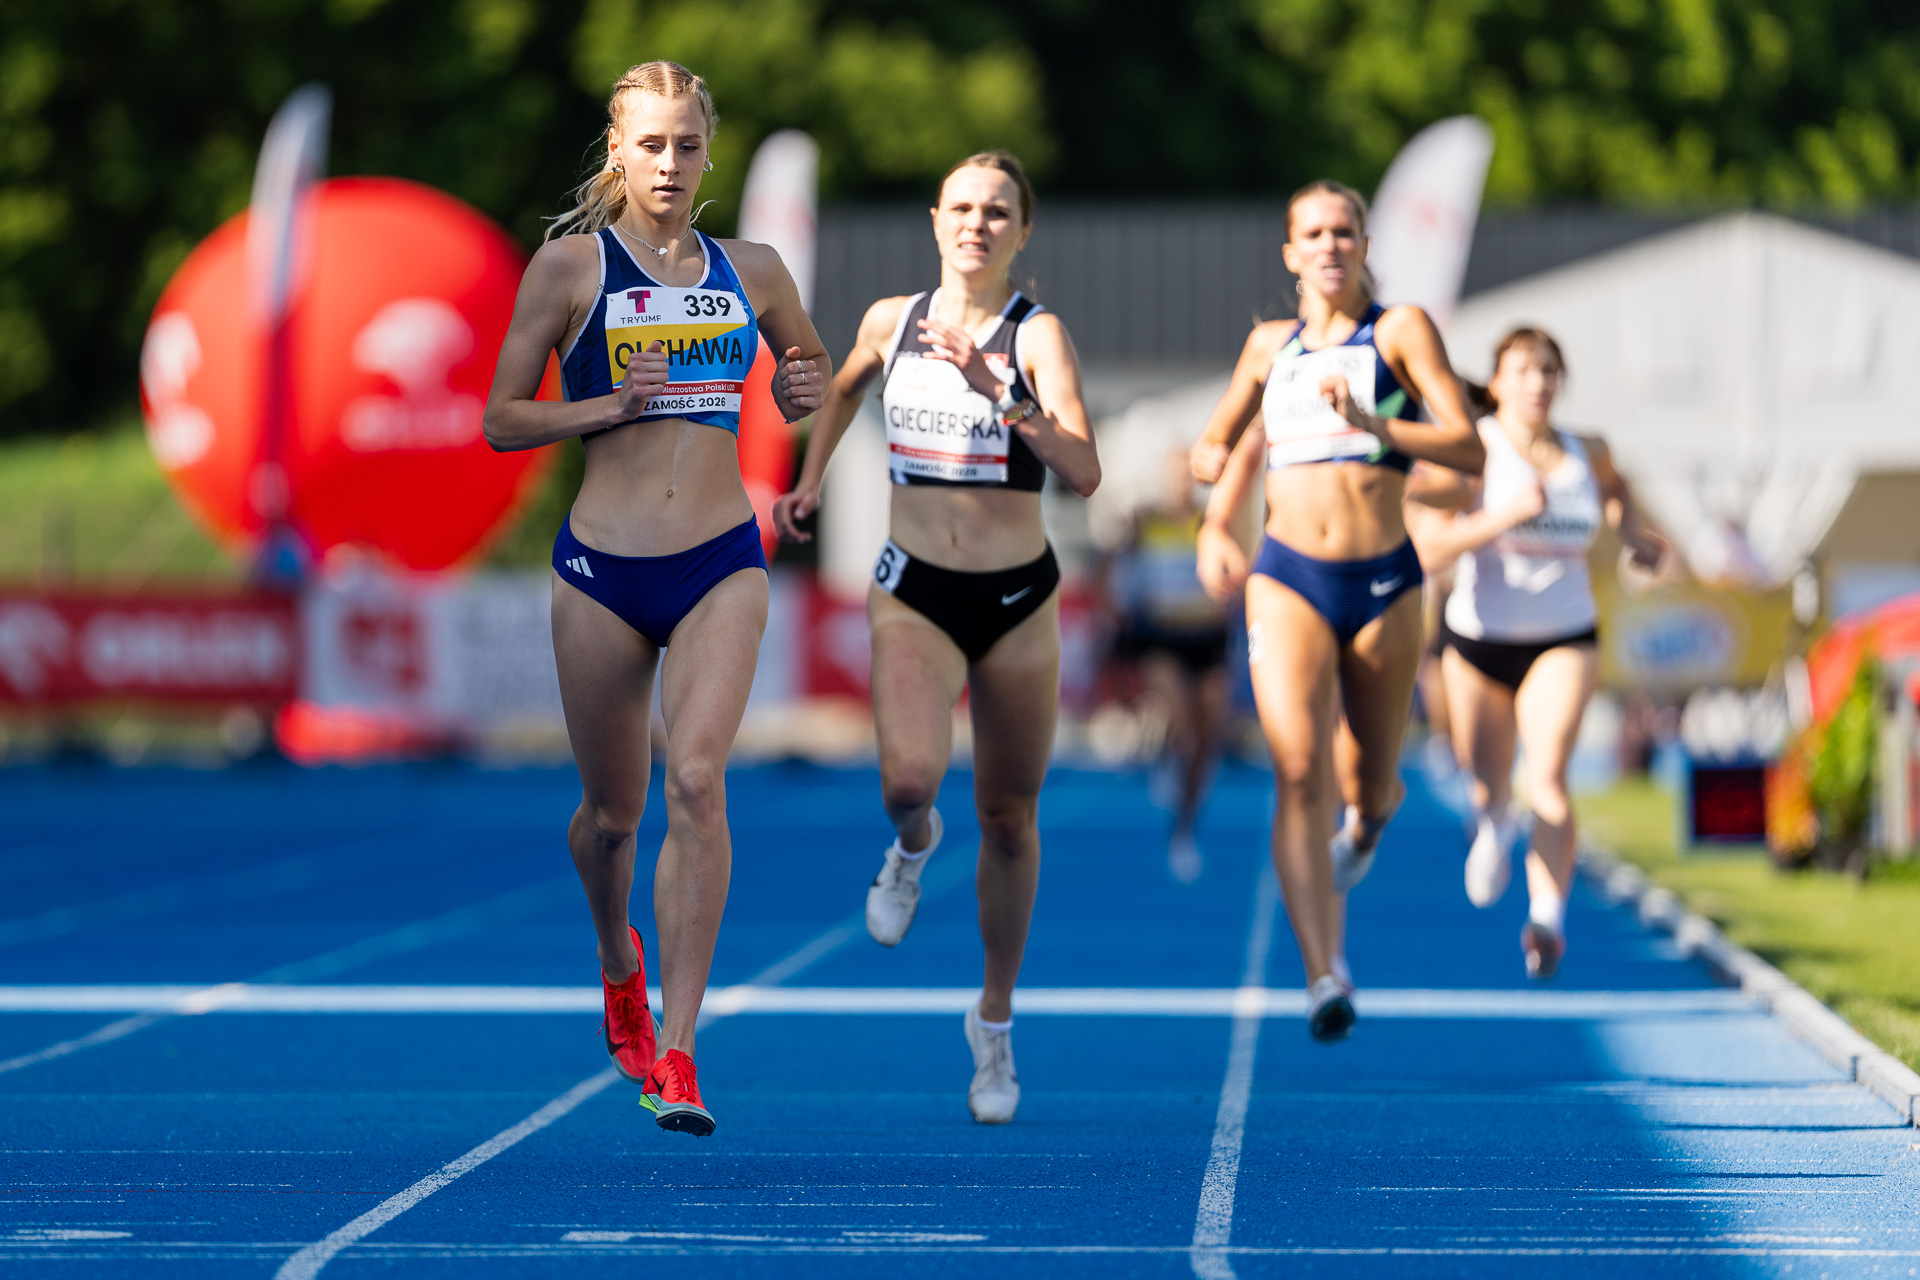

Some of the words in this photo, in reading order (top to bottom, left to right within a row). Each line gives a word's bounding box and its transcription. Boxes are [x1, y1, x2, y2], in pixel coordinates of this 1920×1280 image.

[683, 294, 731, 317] 339
[620, 315, 662, 325] TRYUMF
[614, 337, 743, 370] OHAWA
[705, 383, 727, 391] Polski
[644, 396, 696, 411] ZAMOŚĆ
[698, 397, 726, 408] 2026
[889, 405, 1002, 440] CIECIERSKA
[875, 547, 895, 584] 6
